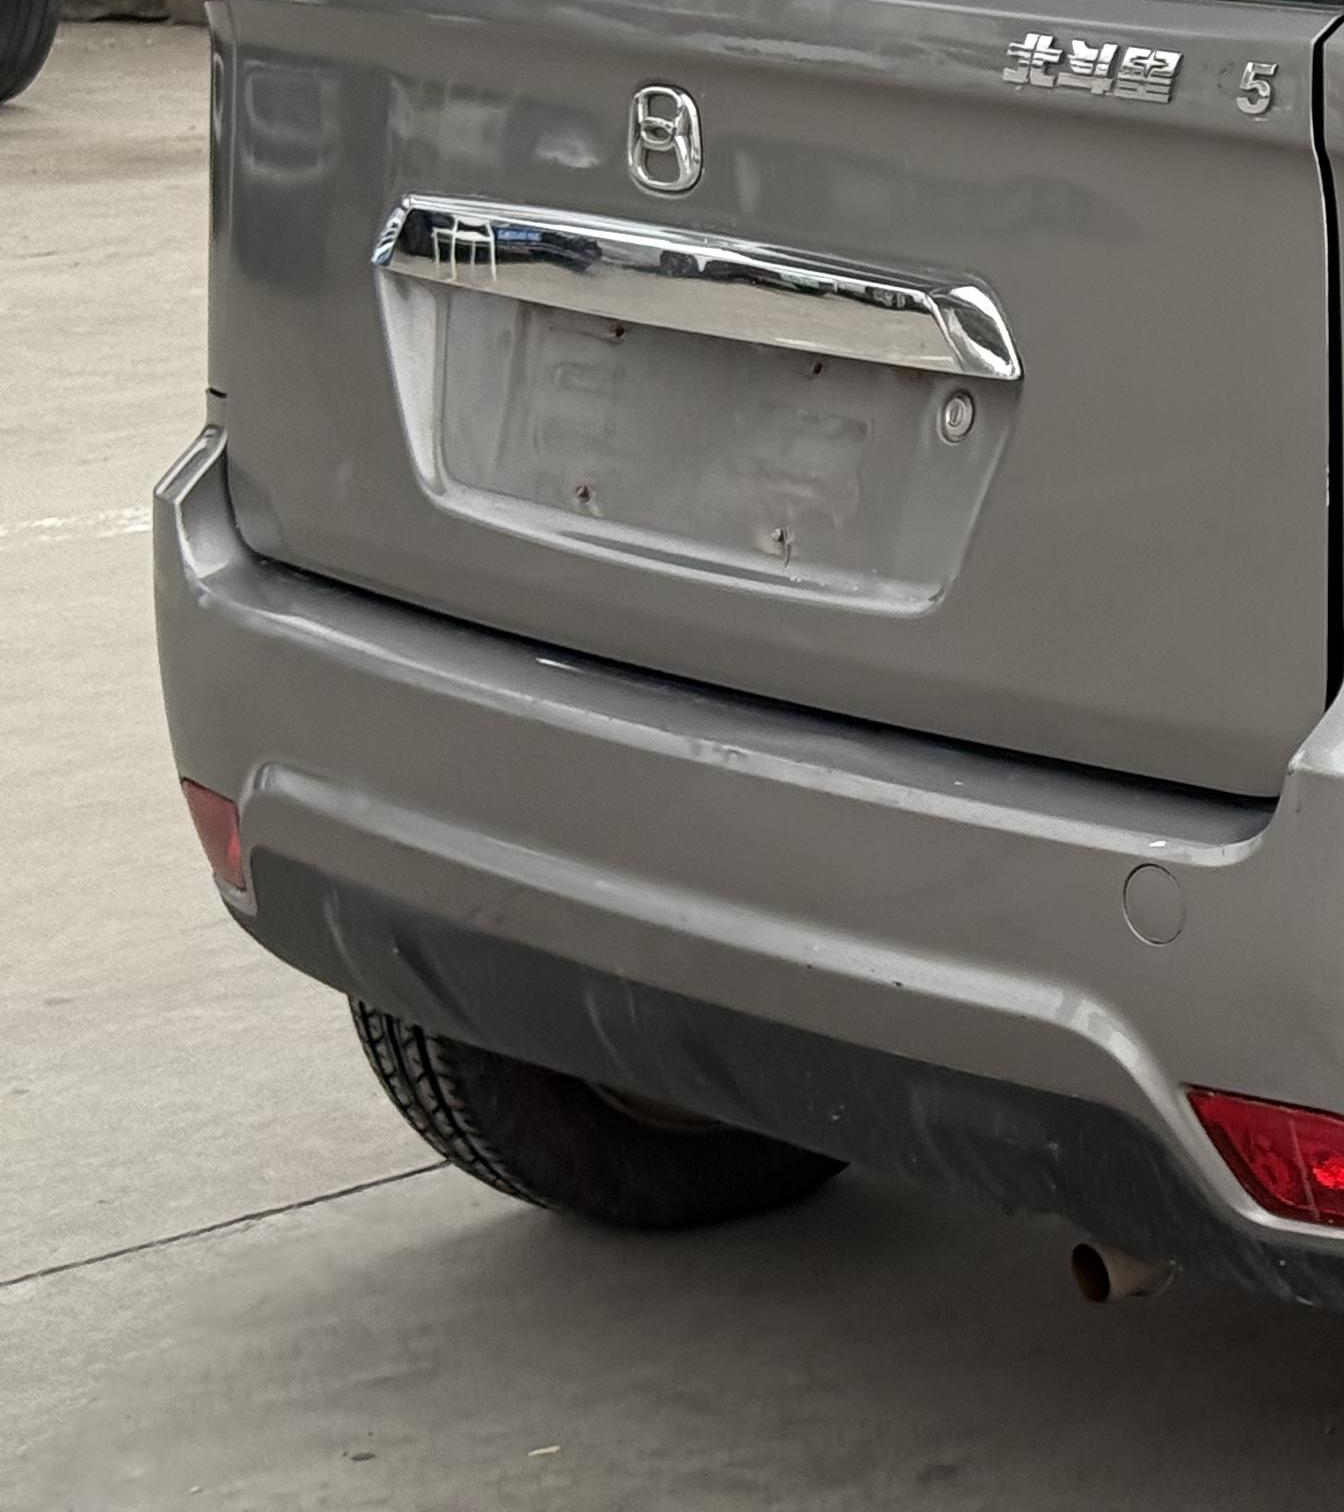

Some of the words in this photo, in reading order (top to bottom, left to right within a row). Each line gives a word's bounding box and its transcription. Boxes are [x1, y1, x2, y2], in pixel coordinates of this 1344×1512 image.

[1002, 32, 1183, 104] 北斗星
[1236, 61, 1278, 115] 5
